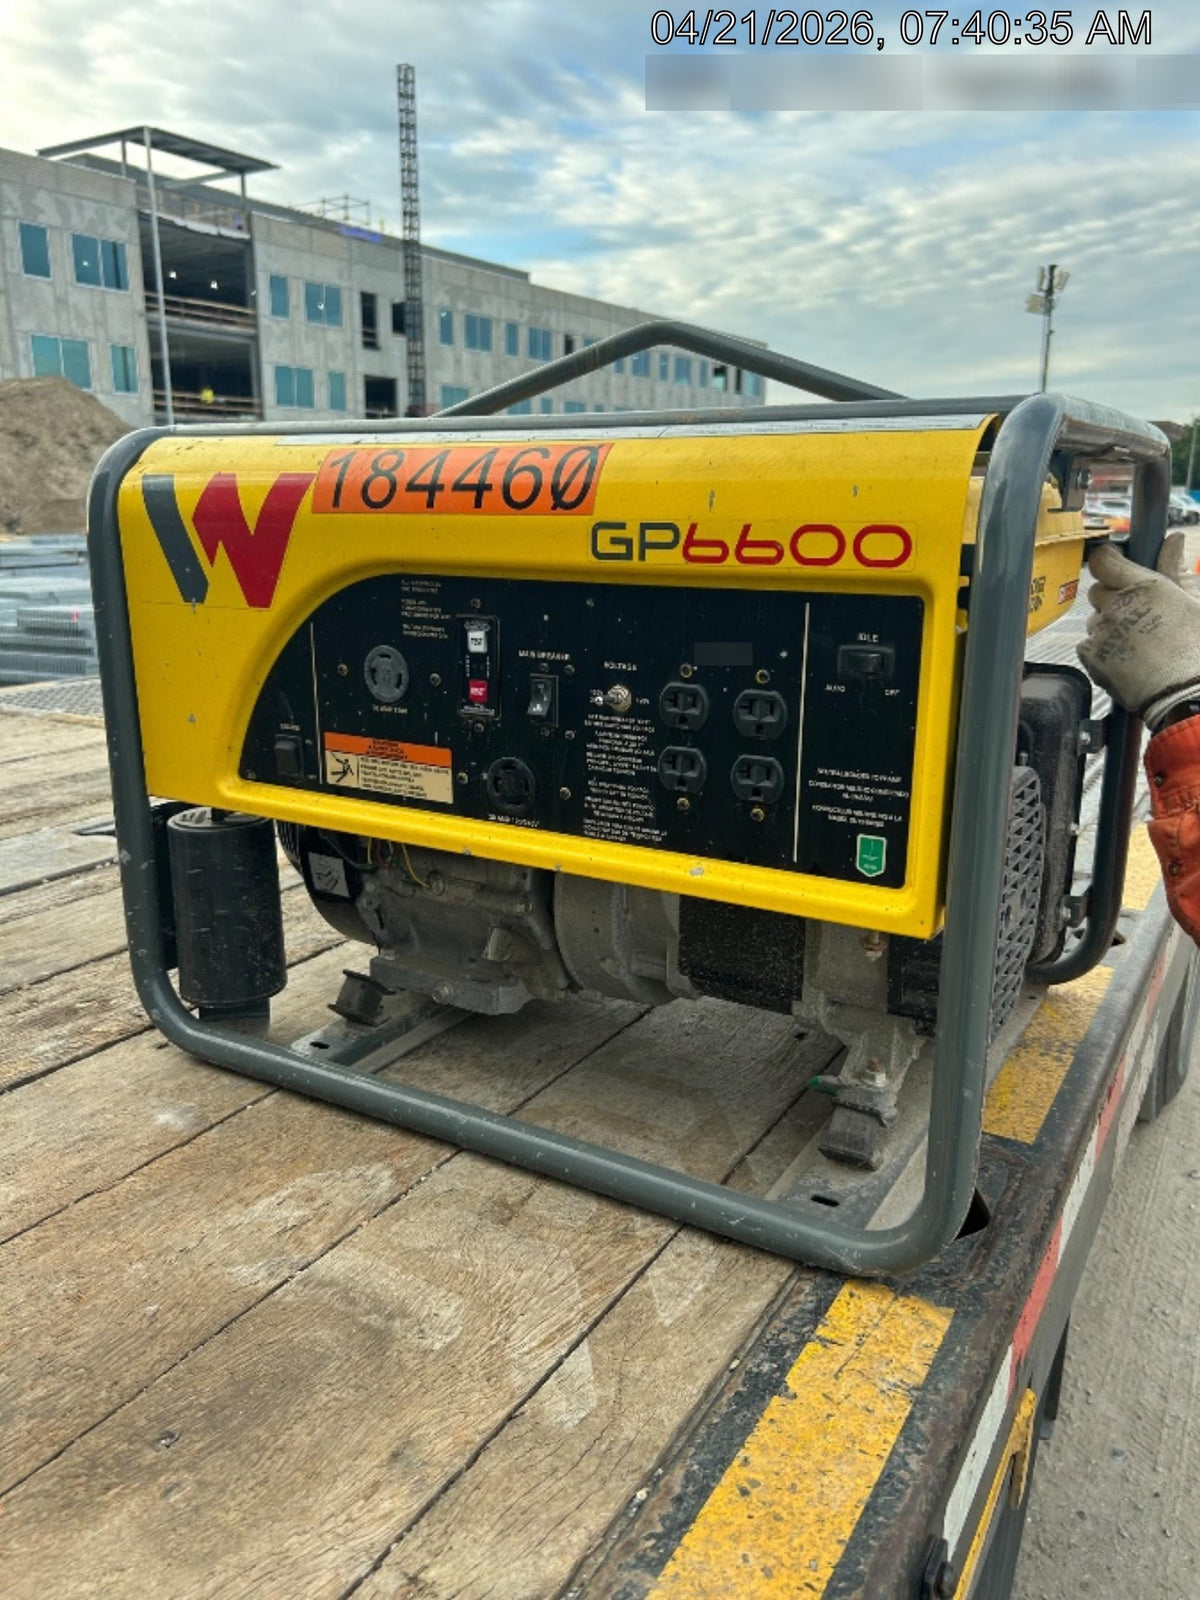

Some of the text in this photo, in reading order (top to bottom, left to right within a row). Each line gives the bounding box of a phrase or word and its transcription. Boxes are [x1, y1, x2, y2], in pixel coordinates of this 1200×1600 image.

[329, 444, 603, 511] 184460
[591, 521, 913, 569] GP6600
[857, 632, 880, 643] IDLE
